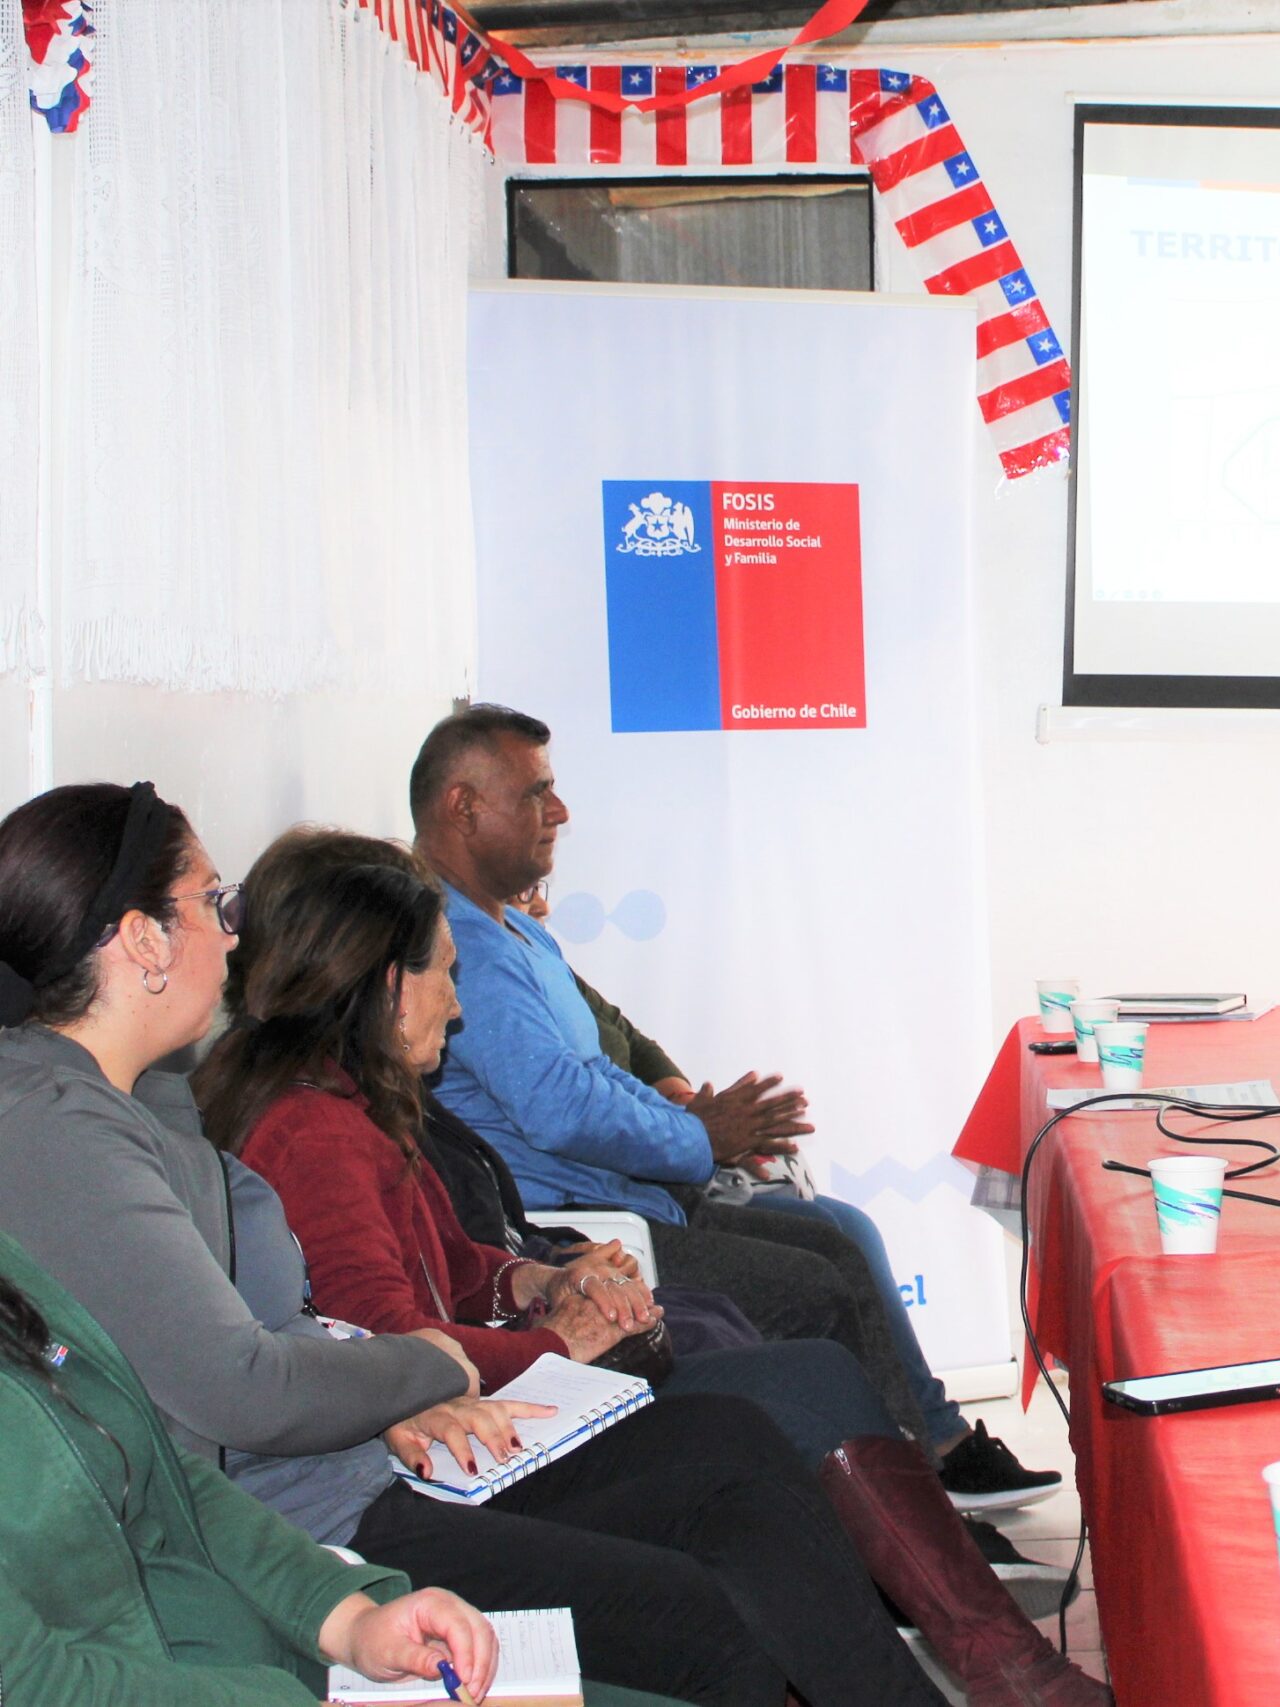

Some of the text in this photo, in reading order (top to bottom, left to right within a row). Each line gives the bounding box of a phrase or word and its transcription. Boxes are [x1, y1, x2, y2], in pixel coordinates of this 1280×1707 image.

[722, 493, 775, 511] FOSIS
[723, 517, 800, 530] Ministerio de
[724, 534, 821, 548] Desarrollo Social
[725, 552, 777, 566] y Familia
[731, 703, 857, 719] Gobierno de Chile
